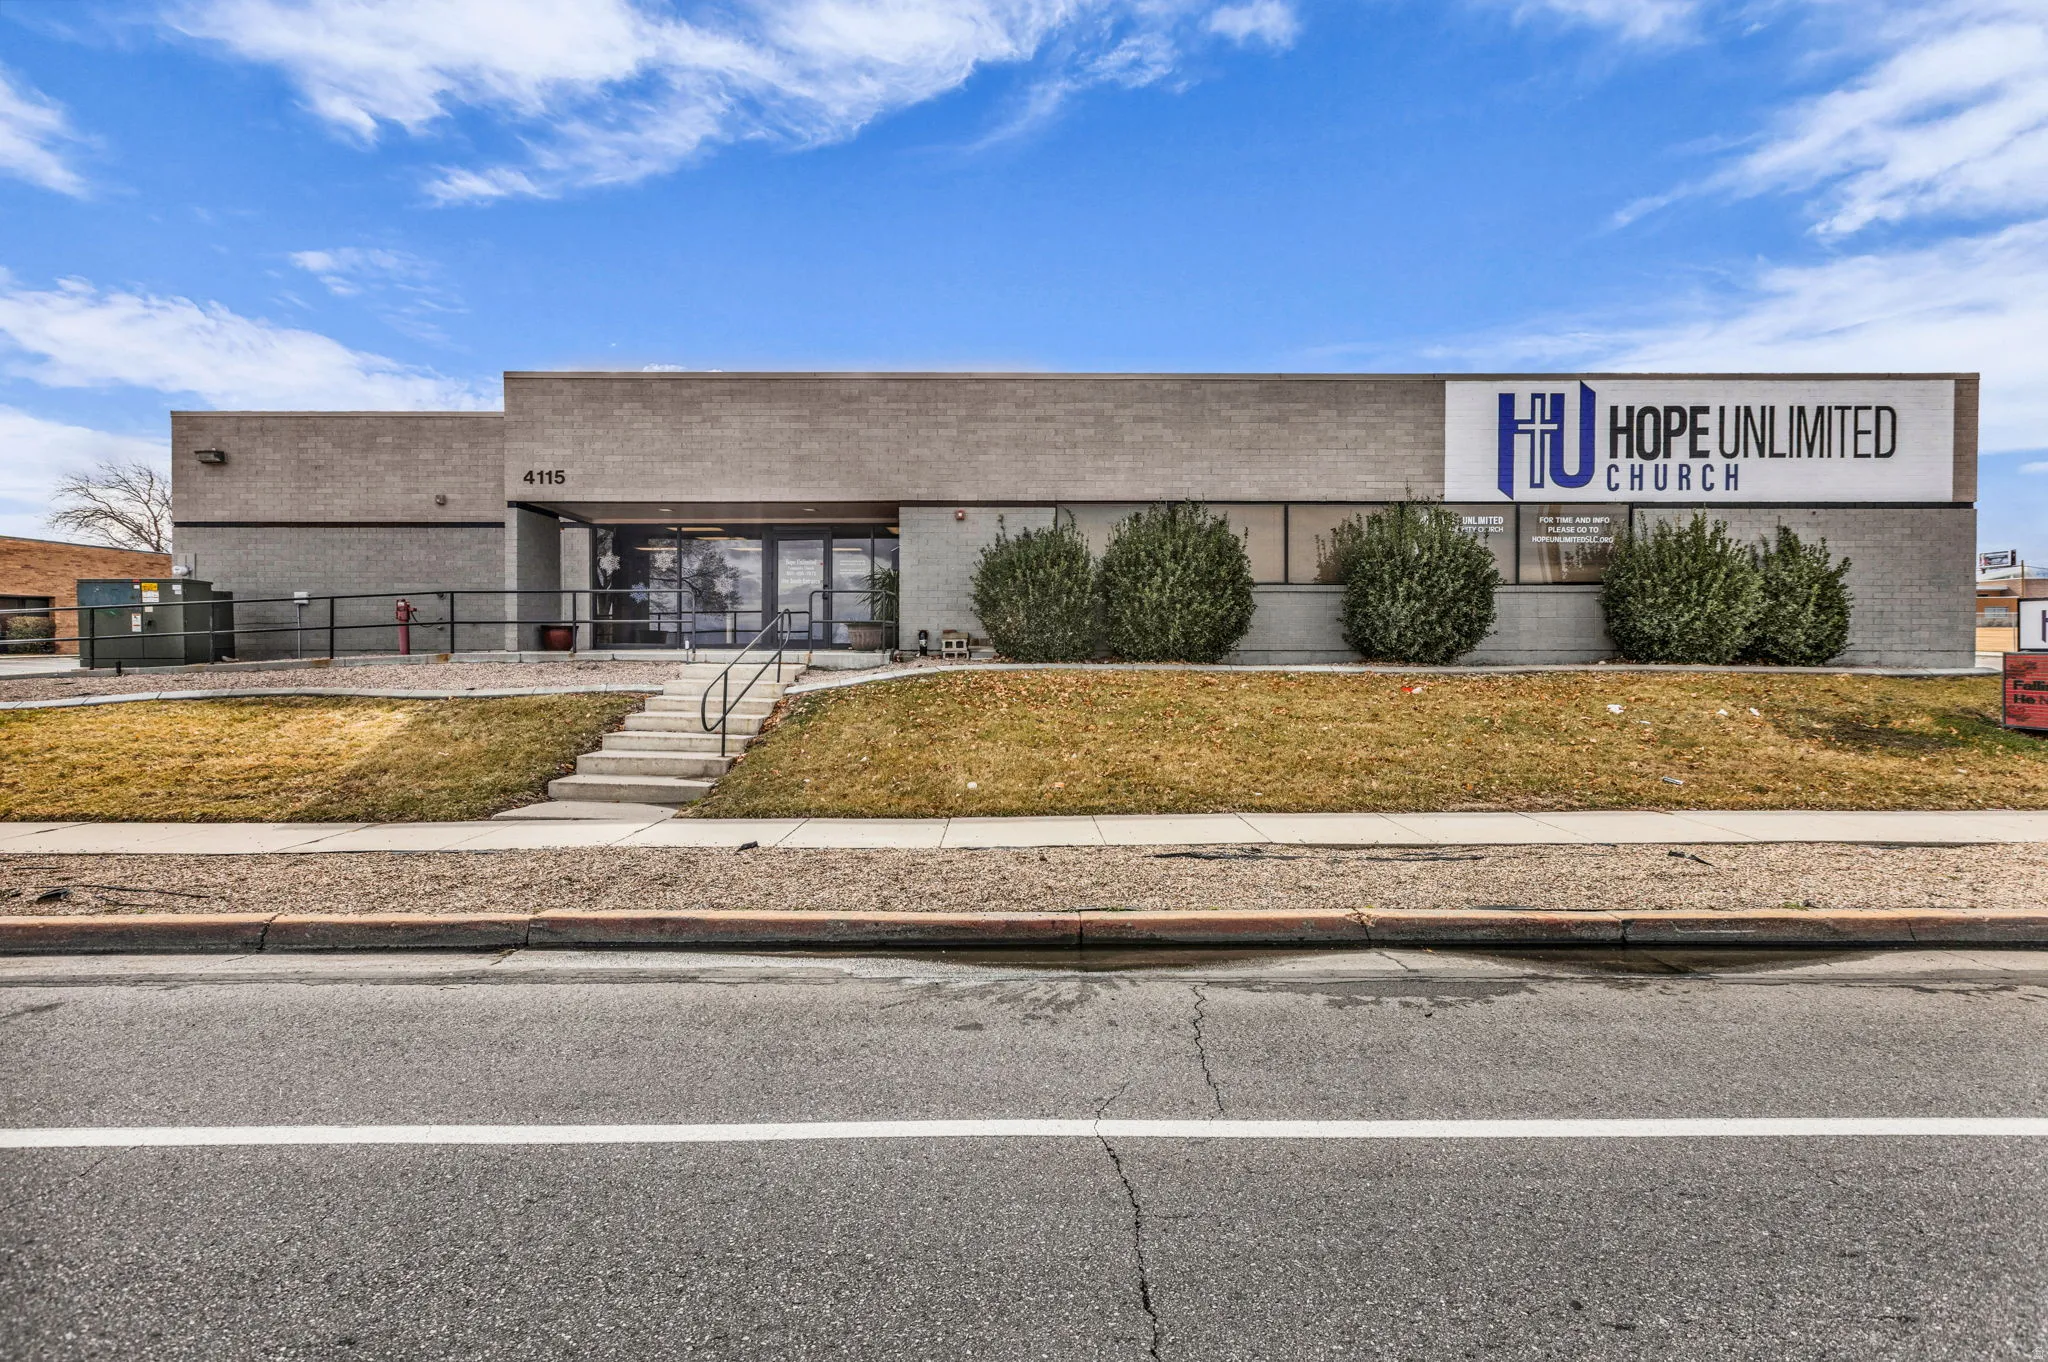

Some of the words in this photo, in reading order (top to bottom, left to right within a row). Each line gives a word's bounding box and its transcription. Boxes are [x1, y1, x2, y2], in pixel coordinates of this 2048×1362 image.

[1609, 405, 1710, 461] HOPE
[1718, 405, 1897, 459] UNLIMITED
[523, 470, 565, 485] 4115
[1606, 463, 1739, 491] CHURCH
[1462, 516, 1504, 525] UNLIMITED
[1539, 516, 1554, 524] FOR
[1555, 516, 1573, 524] TIME
[1574, 516, 1591, 524] AND
[1592, 516, 1610, 524] INFO
